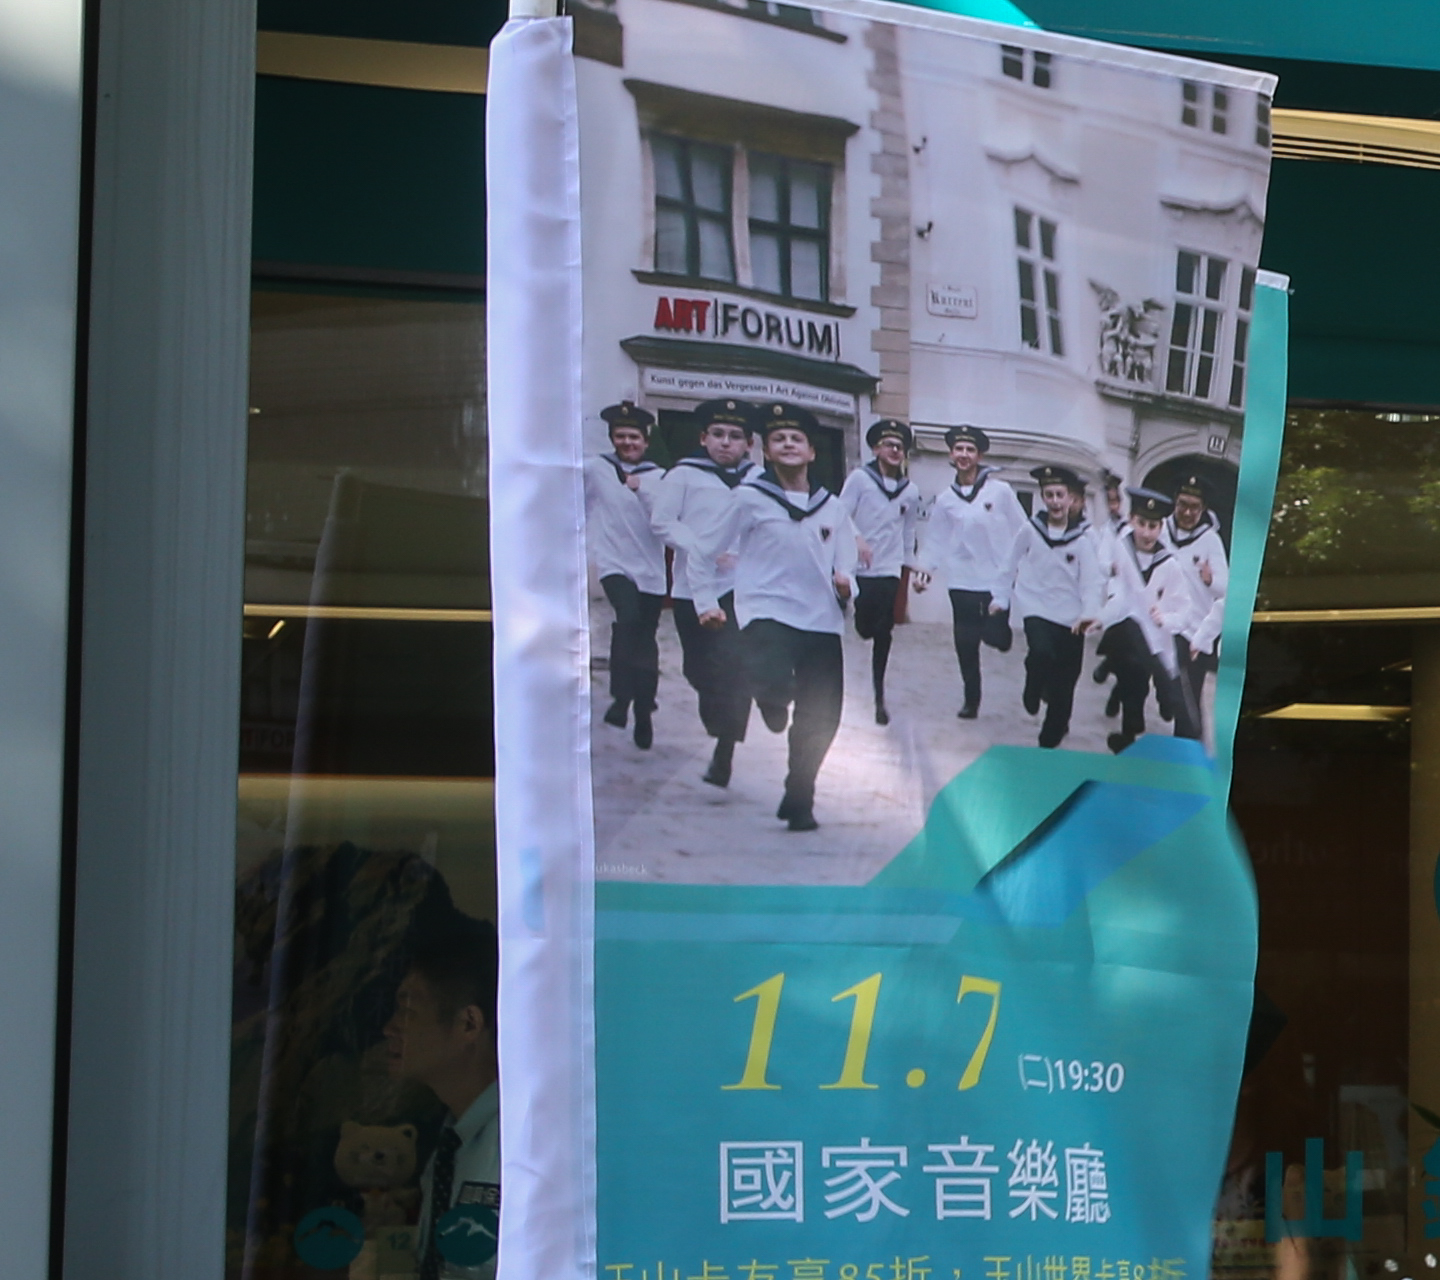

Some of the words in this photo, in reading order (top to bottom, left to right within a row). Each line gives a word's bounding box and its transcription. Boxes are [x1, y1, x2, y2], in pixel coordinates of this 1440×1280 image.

[719, 970, 1001, 1092] 11.7
[719, 1135, 1112, 1224] 國家音樂廳
